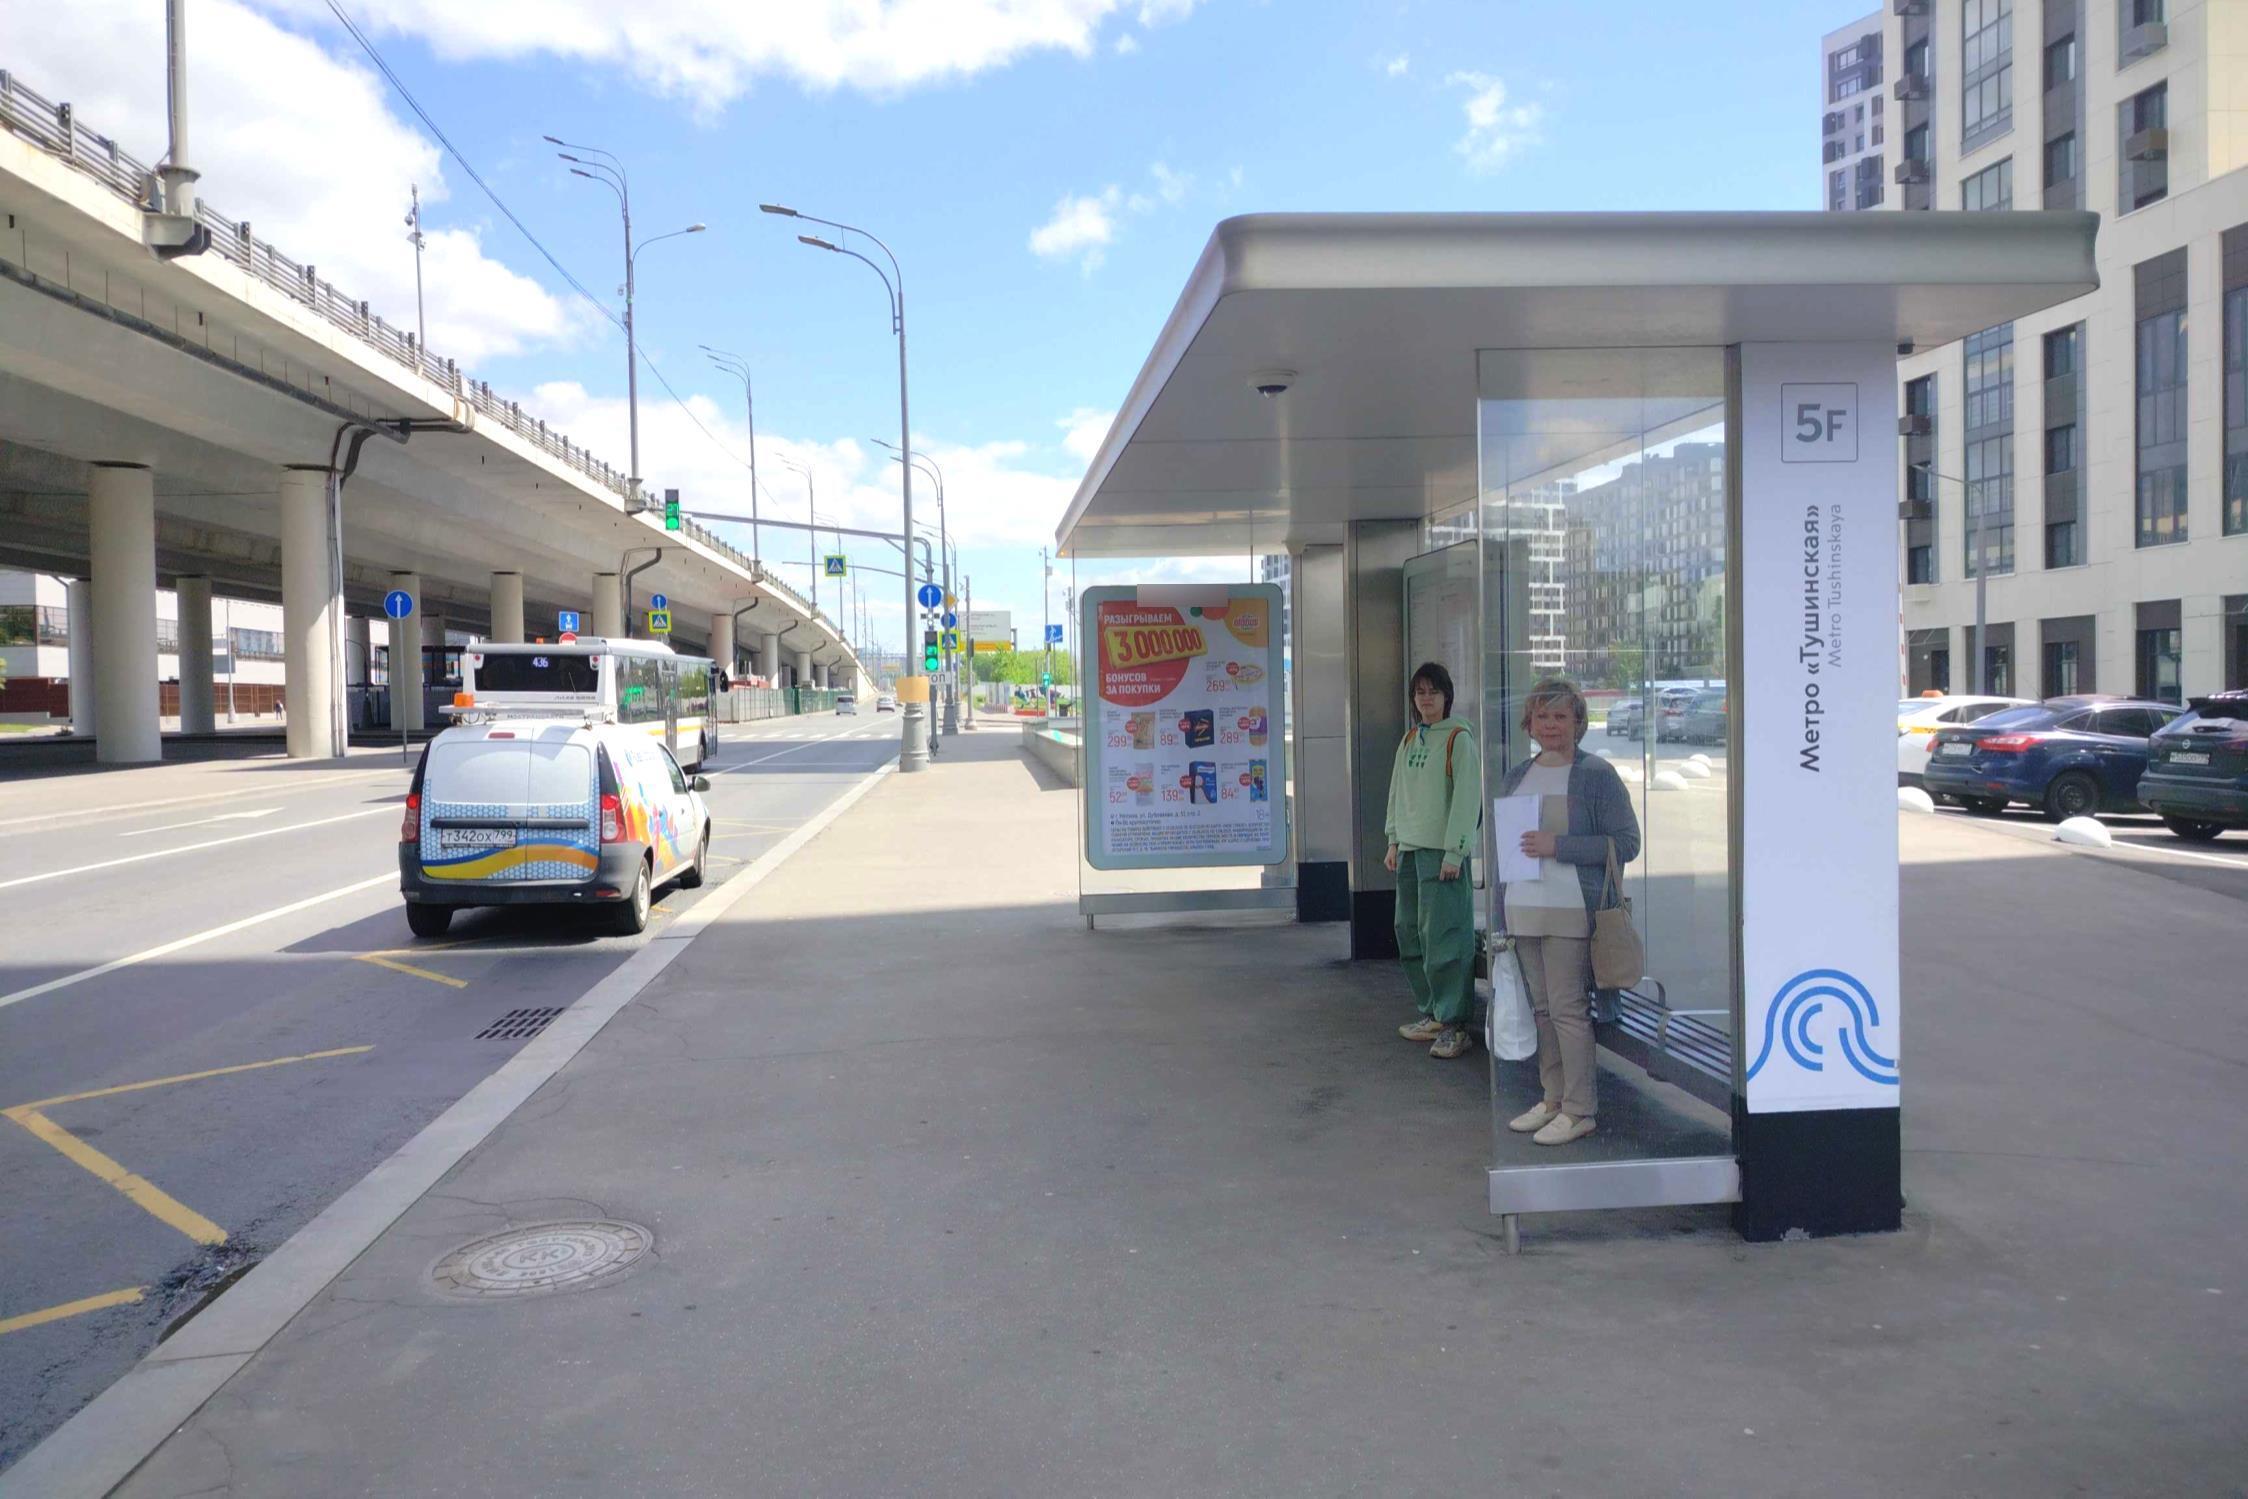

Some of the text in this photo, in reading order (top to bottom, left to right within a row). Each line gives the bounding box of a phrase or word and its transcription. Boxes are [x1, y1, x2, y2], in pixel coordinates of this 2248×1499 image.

[1795, 404, 1847, 443] 5F
[1828, 504, 1844, 668] Metro Tushinskaya
[1103, 614, 1172, 625] РАЗЫГРЫВАЕМ
[1800, 504, 1825, 773] Метро «Тушинская»
[532, 656, 549, 668] 436
[1105, 672, 1147, 683] БОНУСОВ
[1105, 684, 1161, 695] ЗА ПОКУПКИ
[495, 829, 513, 840] 799
